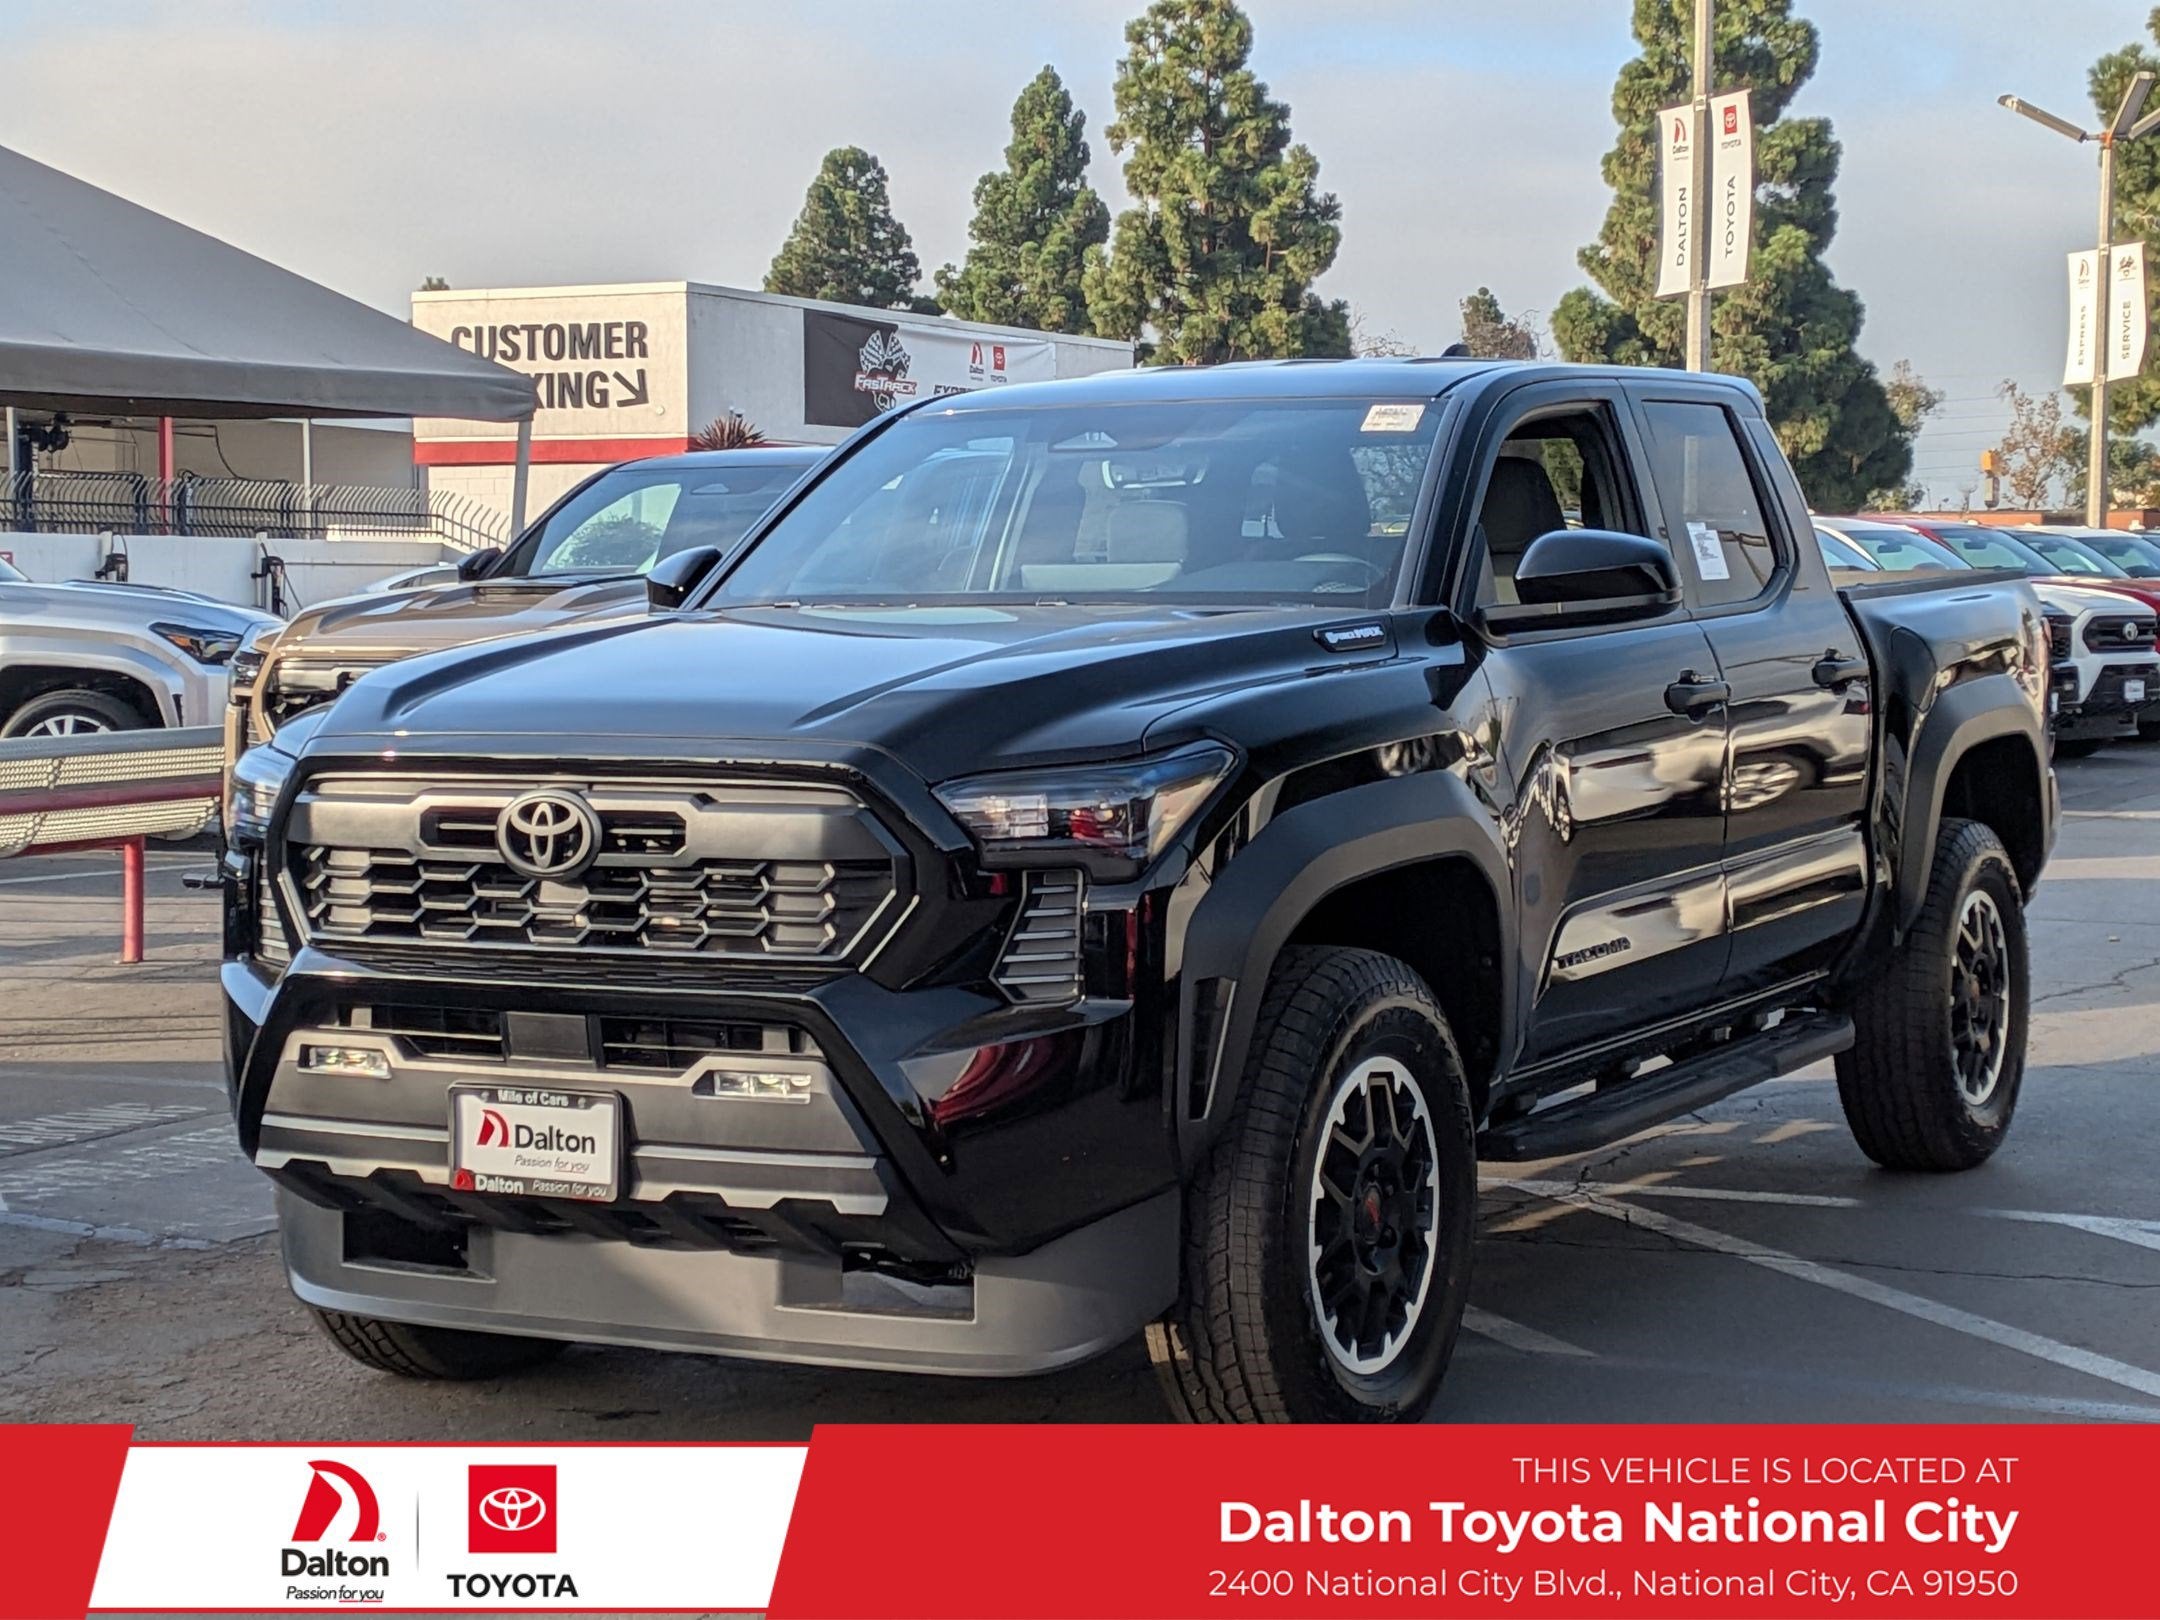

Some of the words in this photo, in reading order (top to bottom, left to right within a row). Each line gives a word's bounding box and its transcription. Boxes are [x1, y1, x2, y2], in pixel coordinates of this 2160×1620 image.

[1676, 187, 1688, 267] DALTON
[1725, 176, 1736, 258] TOYOTA
[2121, 301, 2131, 360] SERVICE
[1558, 936, 1631, 969] TACOMA
[498, 1090, 523, 1104] Mile
[525, 1092, 538, 1105] of
[539, 1094, 569, 1107] Cars
[514, 1124, 596, 1154] Dalton
[514, 1154, 552, 1168] Passion
[554, 1157, 569, 1171] for
[570, 1162, 590, 1173] you
[475, 1175, 525, 1195] Dalton
[533, 1179, 570, 1193] Passion
[571, 1183, 587, 1197] for
[587, 1186, 607, 1198] you
